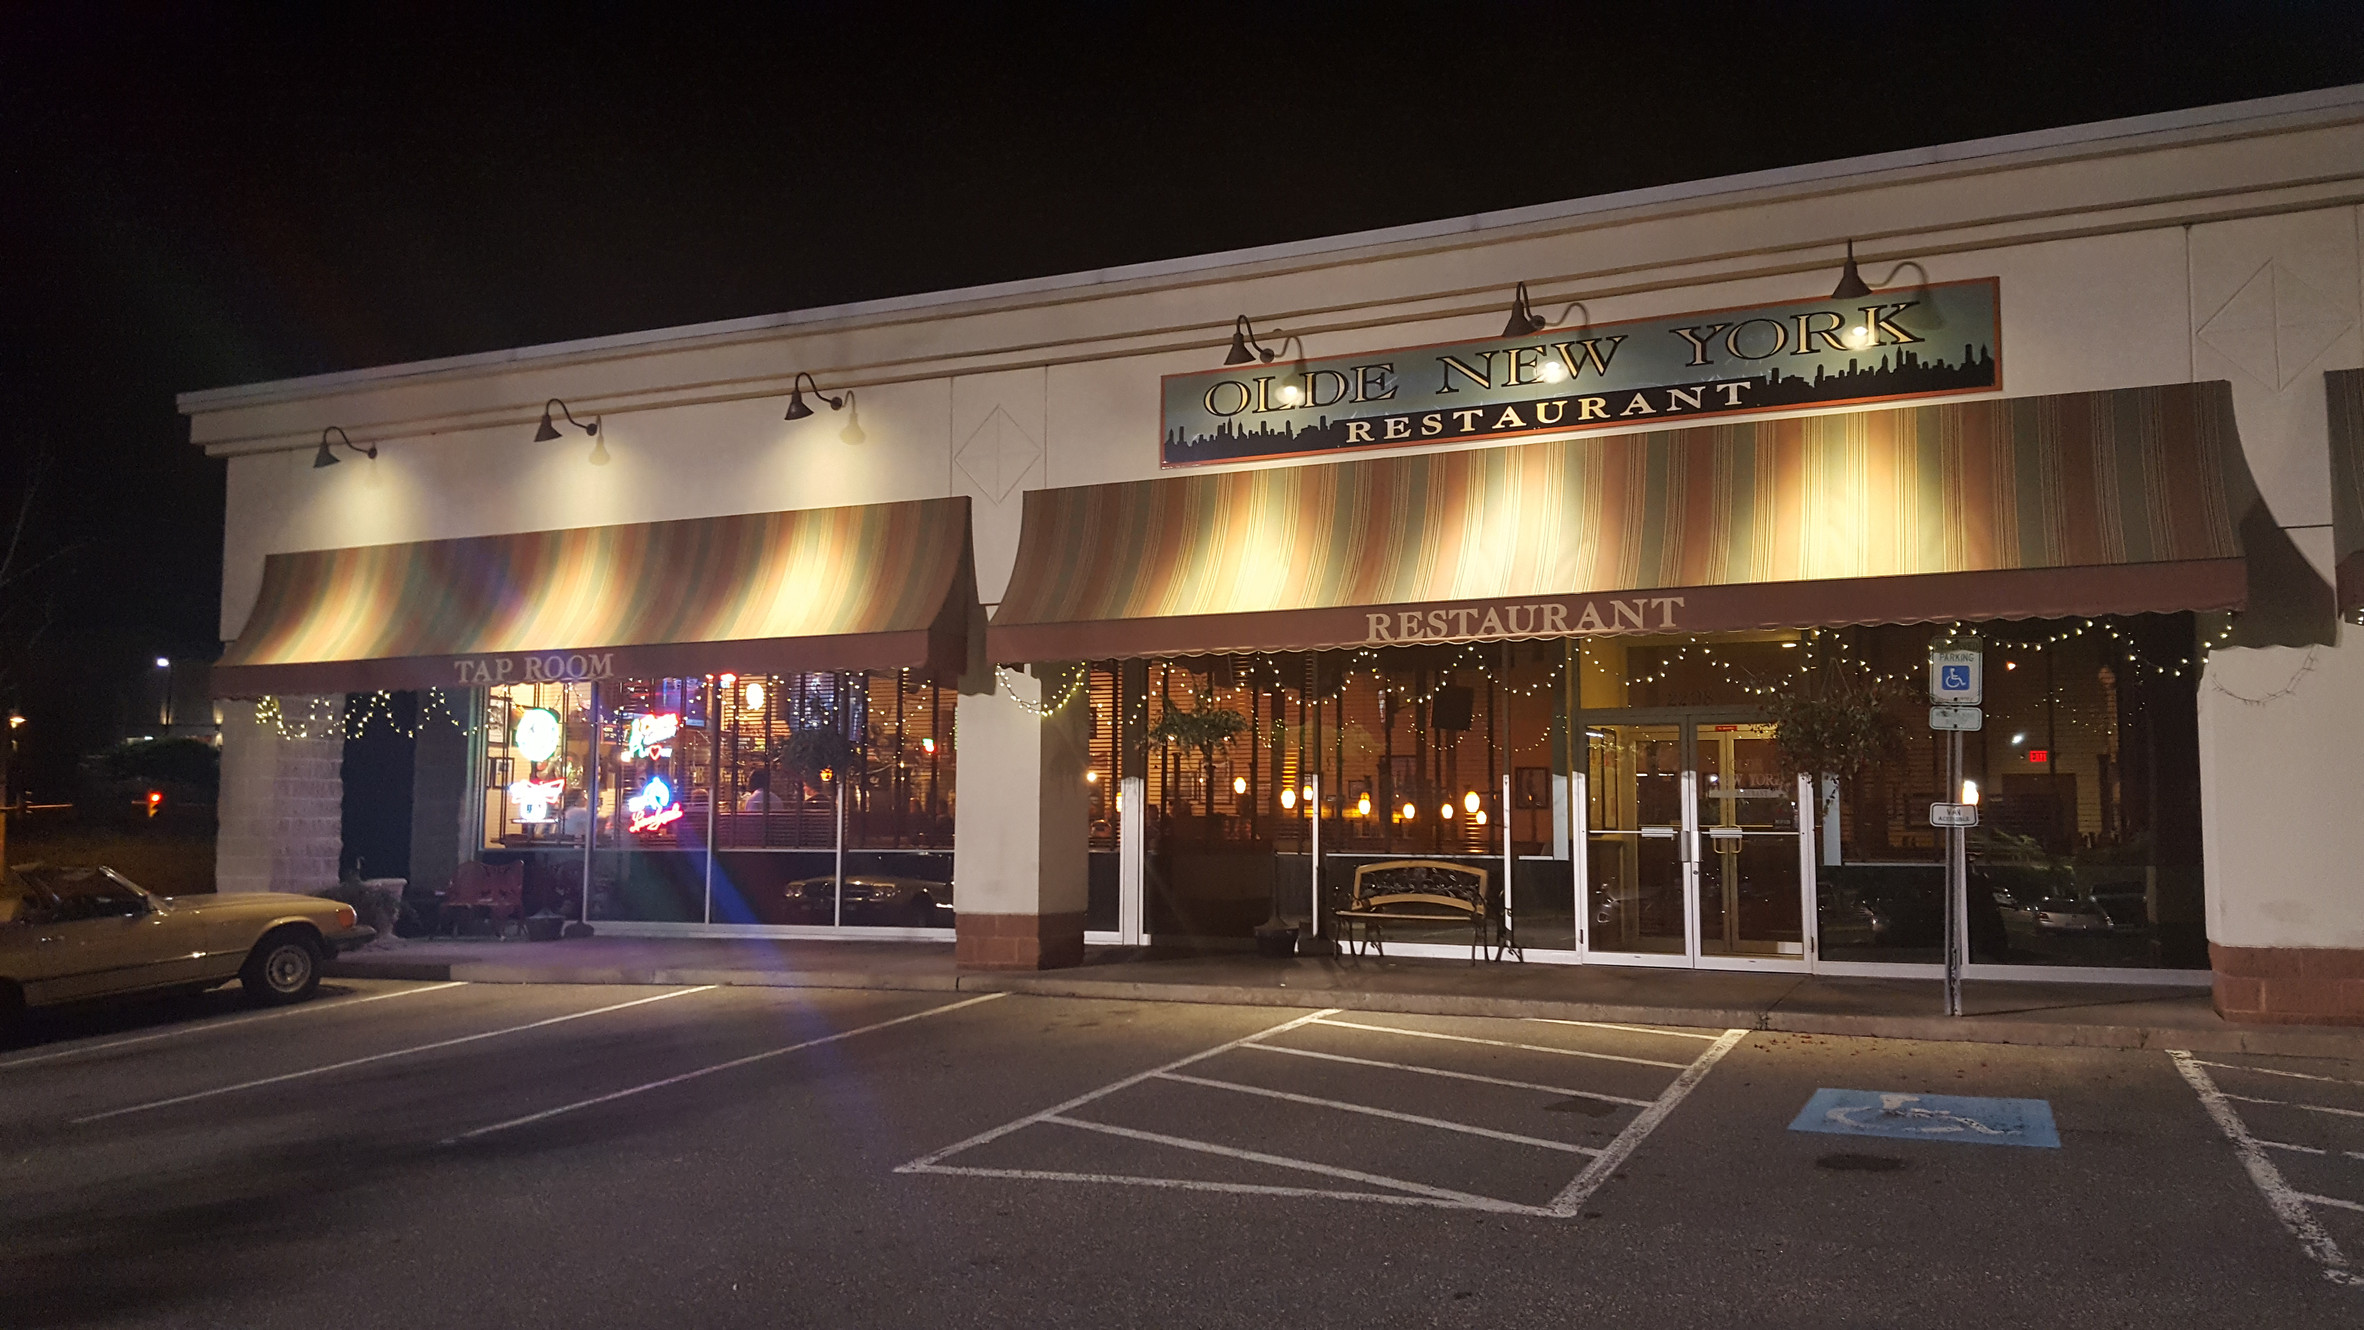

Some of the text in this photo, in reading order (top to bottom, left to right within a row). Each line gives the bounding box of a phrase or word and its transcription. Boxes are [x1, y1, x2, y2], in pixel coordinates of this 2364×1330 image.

[1203, 301, 1926, 417] OLDE NEW YORK
[1346, 381, 1752, 443] RESTAURANT
[1365, 596, 1685, 643] RESTAURANT
[454, 653, 615, 684] TAP ROOM
[1939, 653, 1975, 662] PARKING
